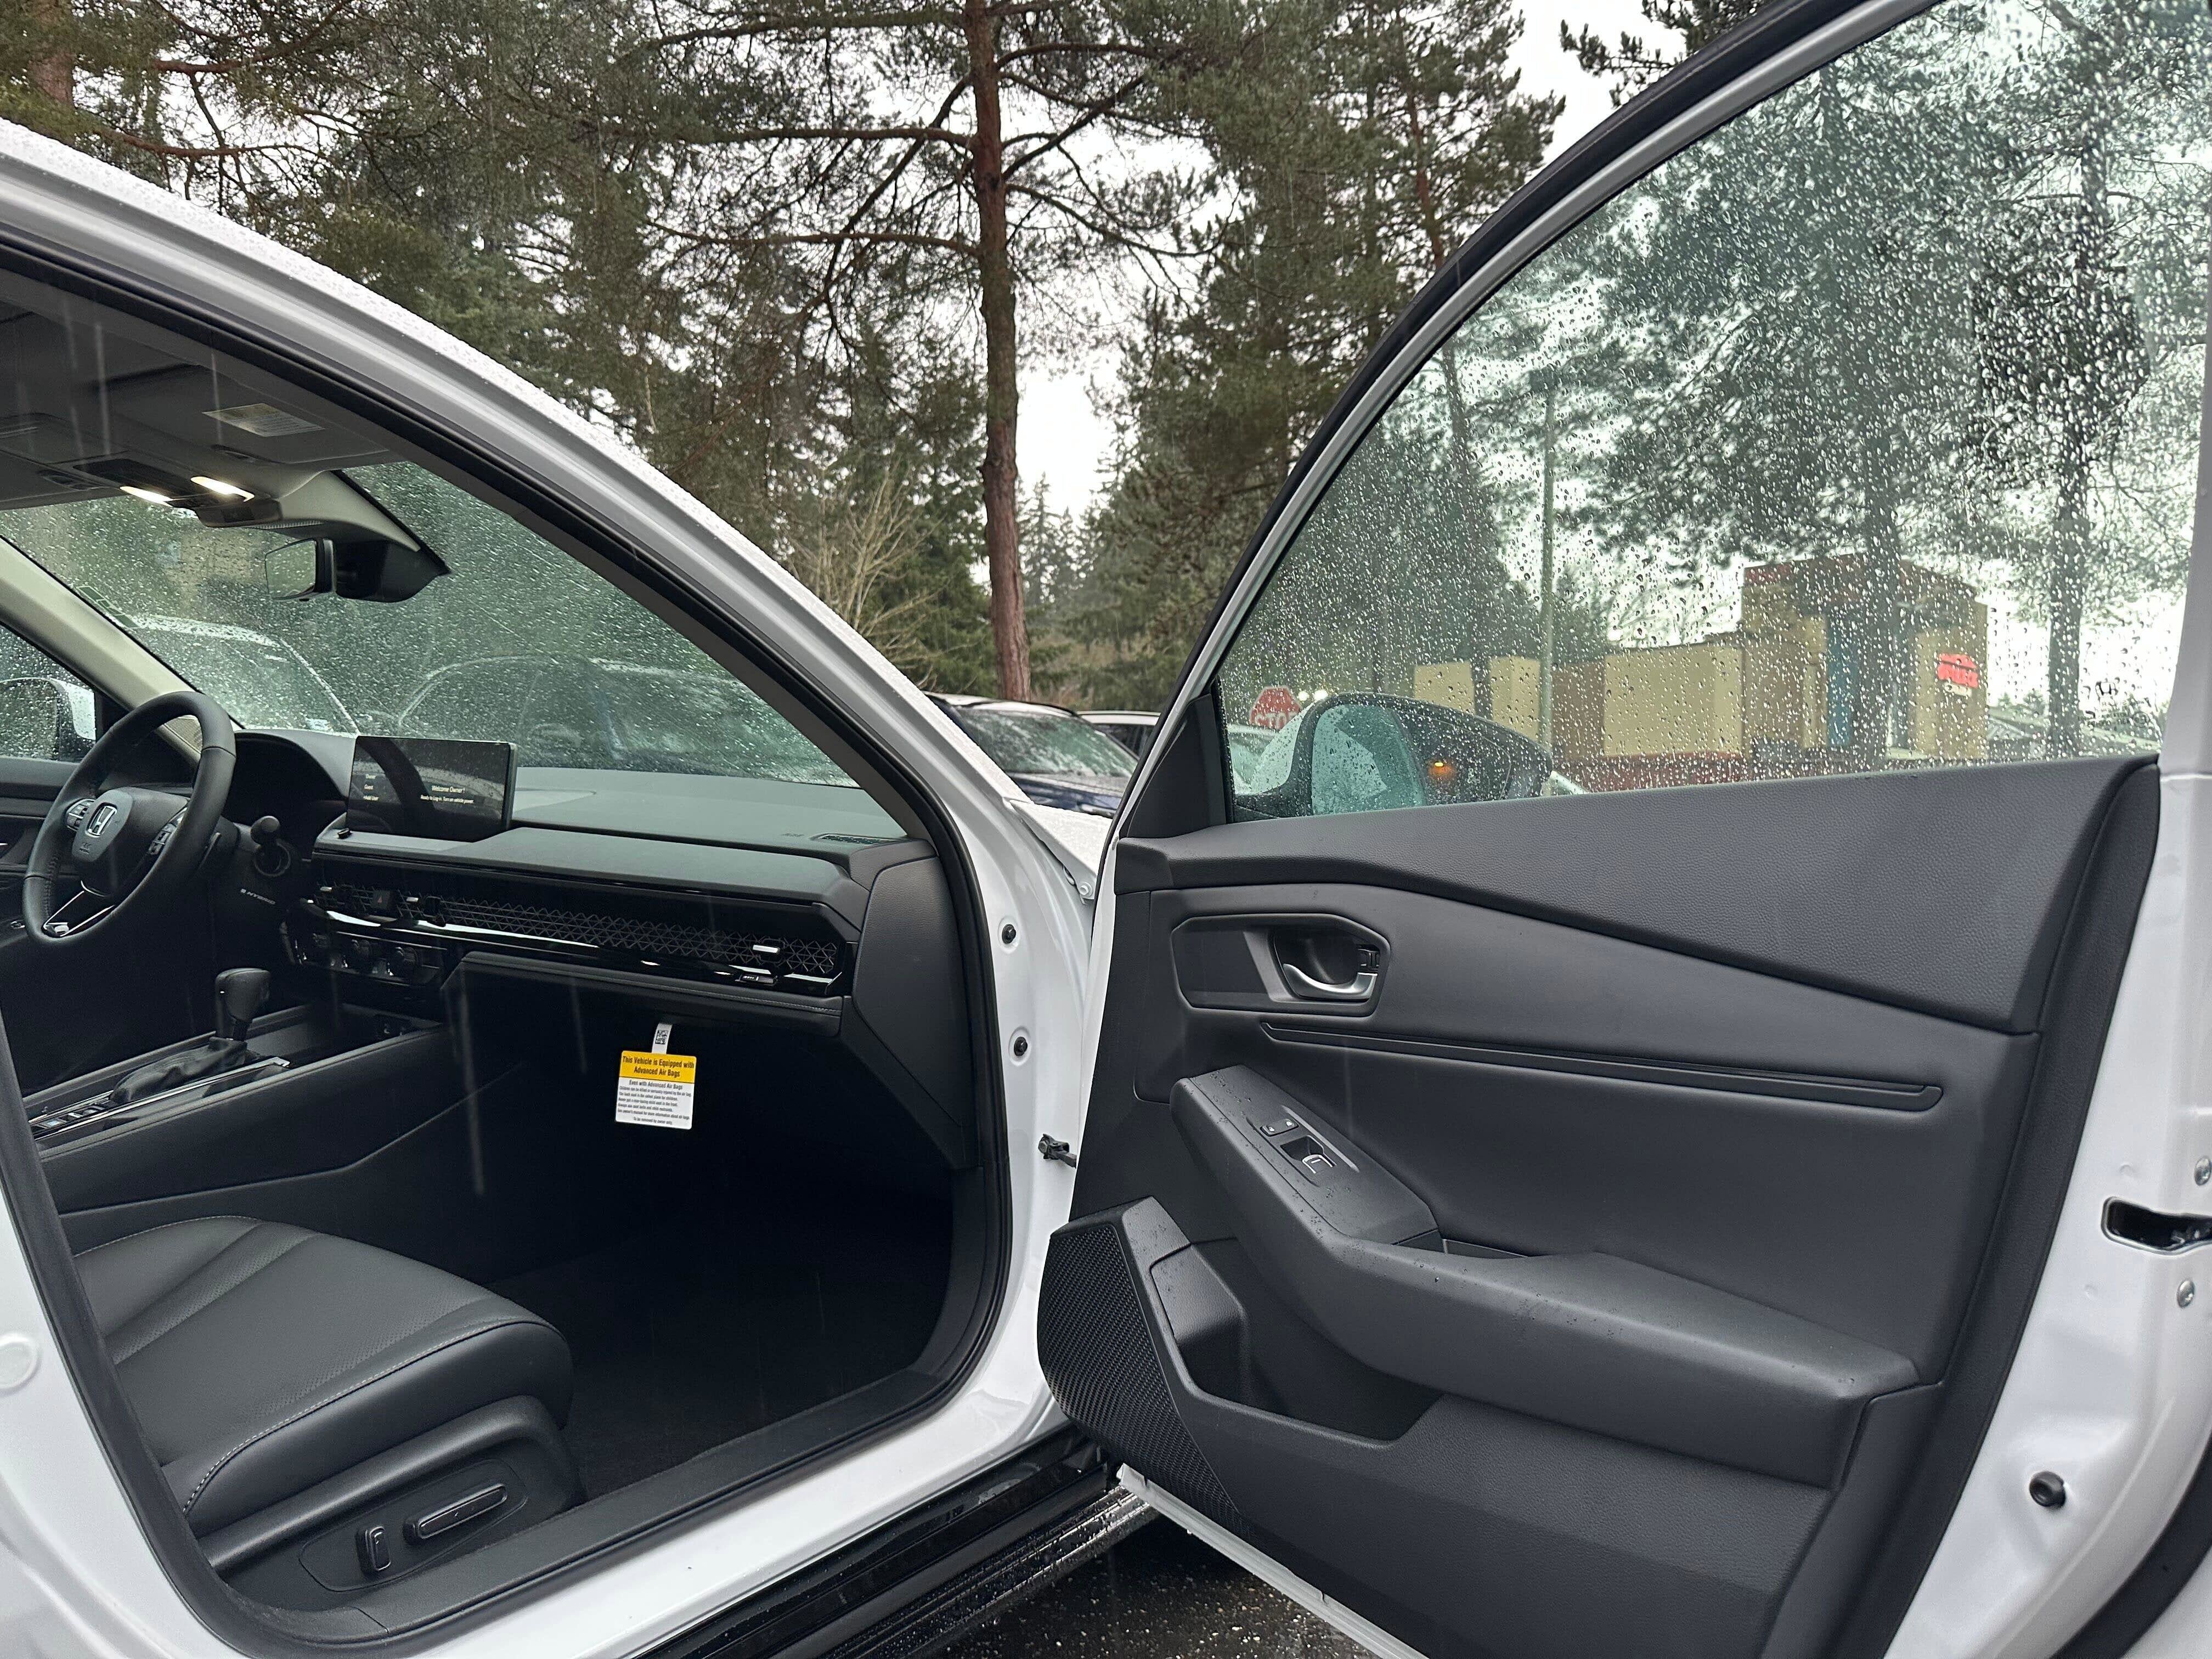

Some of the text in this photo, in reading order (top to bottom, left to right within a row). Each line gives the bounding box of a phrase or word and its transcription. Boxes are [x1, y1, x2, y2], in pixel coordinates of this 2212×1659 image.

[634, 1057, 652, 1065] Vehicle
[659, 1059, 681, 1068] Equipped
[634, 1066, 657, 1075] Advanced
[668, 1069, 680, 1078] Bags
